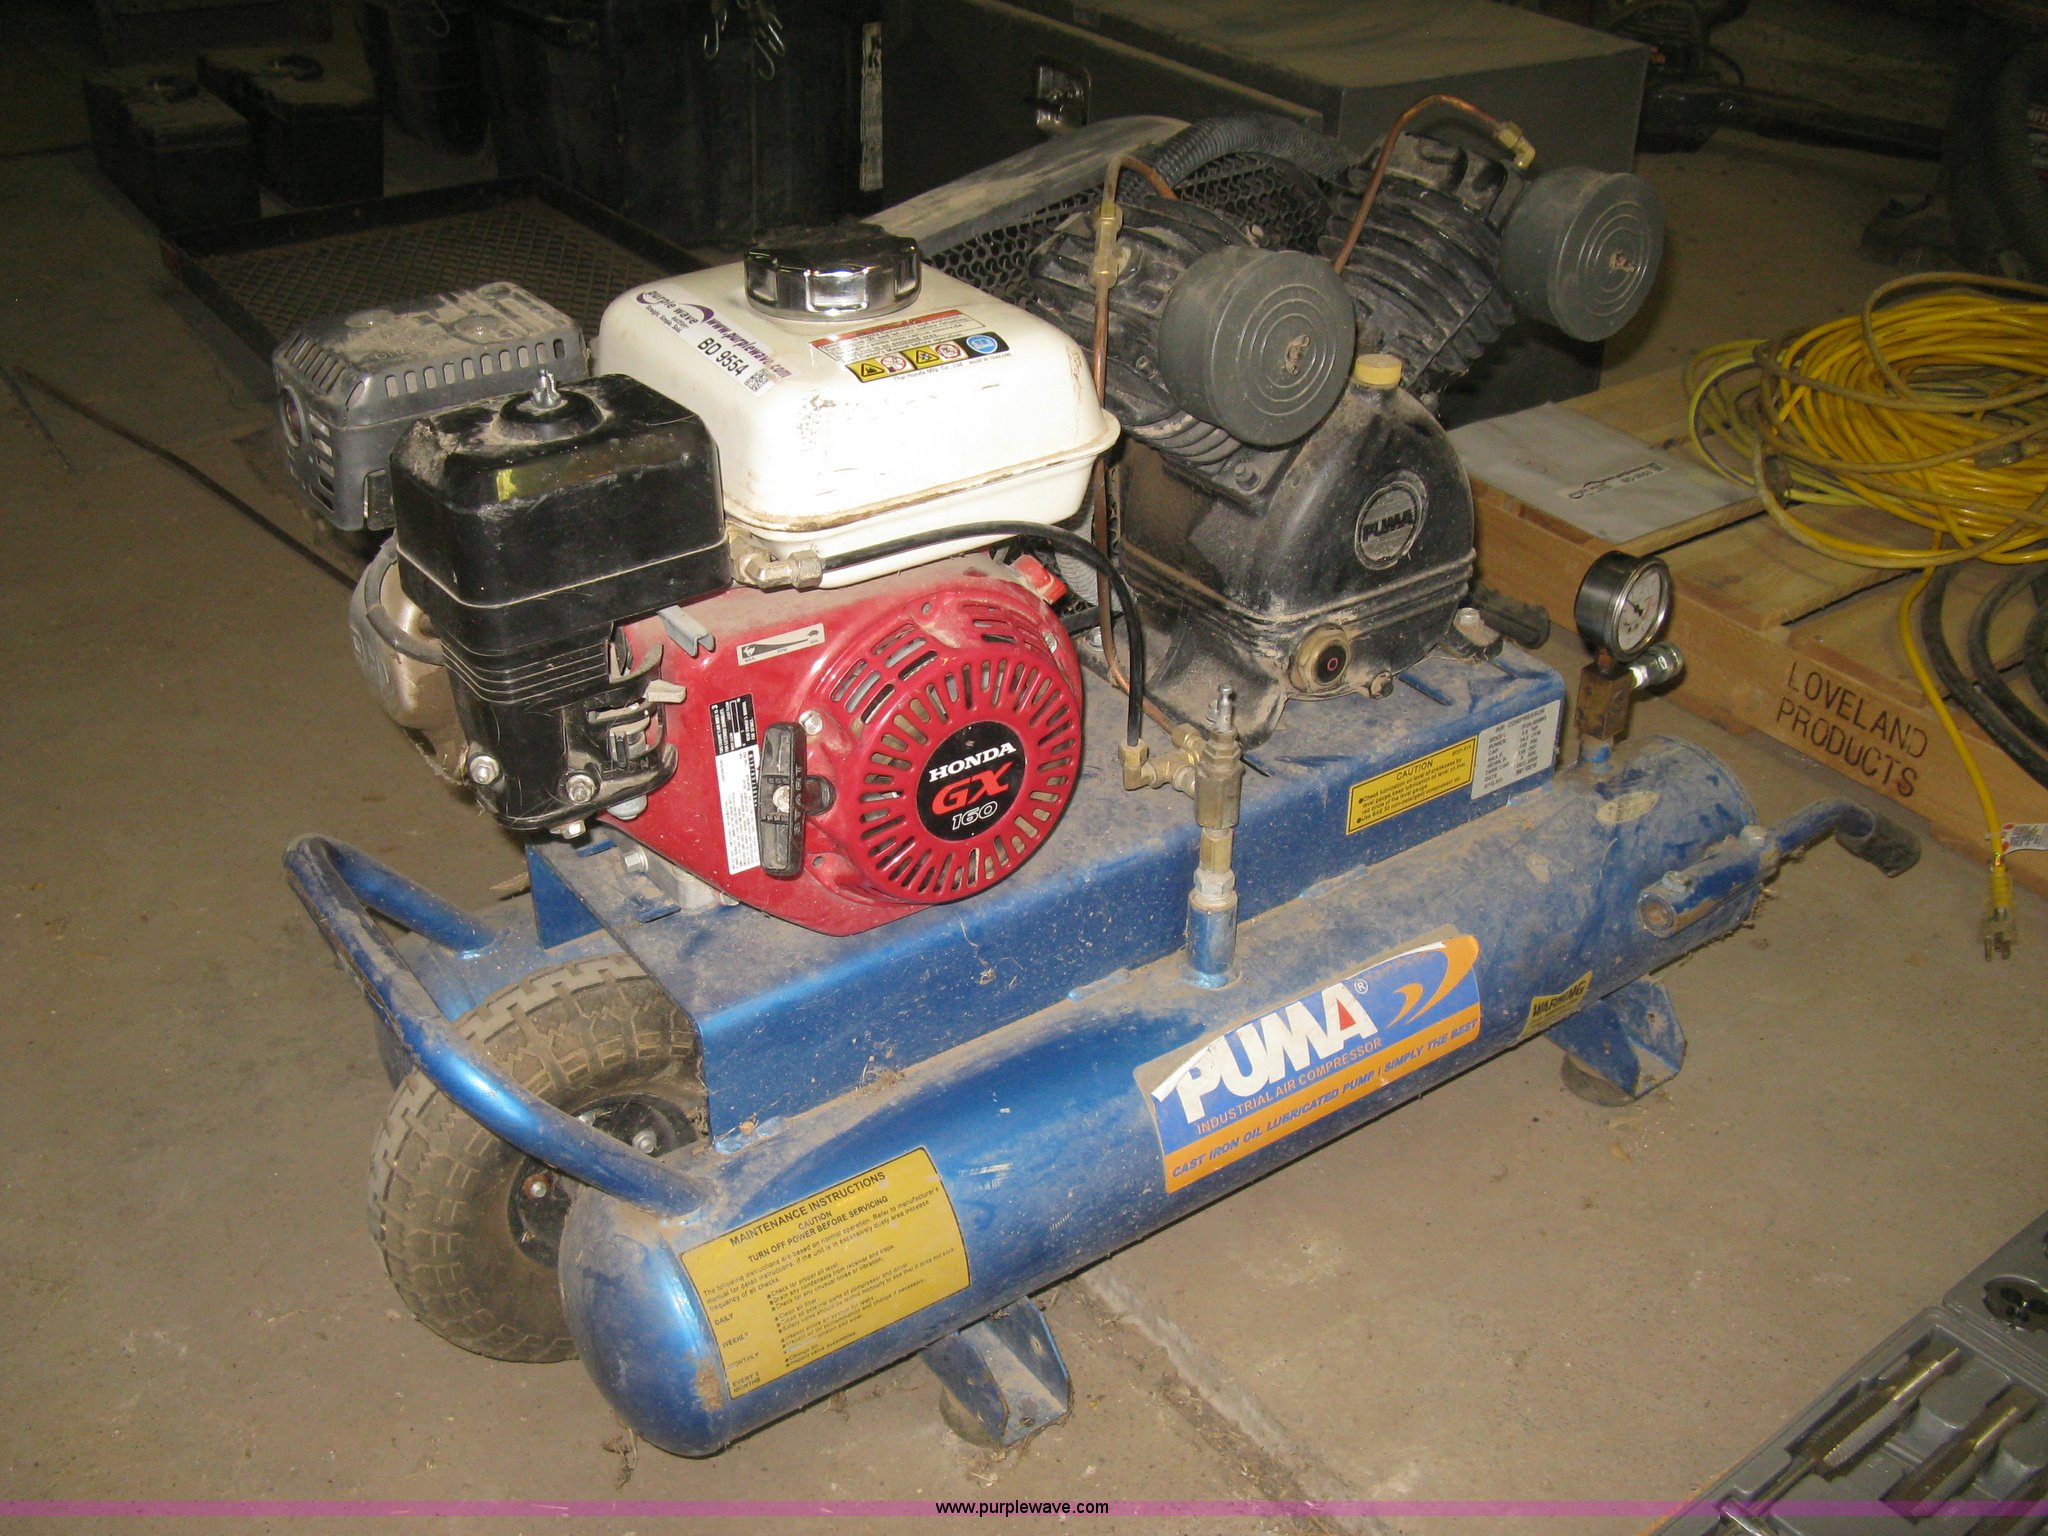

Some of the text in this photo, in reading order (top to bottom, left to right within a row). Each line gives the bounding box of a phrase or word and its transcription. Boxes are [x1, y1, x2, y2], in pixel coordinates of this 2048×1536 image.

[644, 289, 676, 309] purple
[674, 306, 698, 325] wave
[697, 337, 749, 377] BD 9554
[1363, 507, 1415, 542] PUMA
[1787, 661, 1928, 758] LOVELAND
[929, 742, 1016, 782] HONDA
[1776, 696, 1918, 797] PRODUCTS
[931, 761, 1015, 815] GX
[1396, 759, 1433, 780] CAUTION
[952, 800, 998, 831] 160
[1176, 982, 1378, 1125] PUMA
[1171, 1018, 1477, 1178] CAST IRON OIL LUBRICATED PUMP SIMPLY THE BEST
[1195, 1036, 1382, 1135] INDUSTRIAL AIR COMPRESSOR
[729, 1170, 886, 1246] MAINTENANCE INSTRUCTIONS
[797, 1209, 832, 1230] CAUTION
[703, 1286, 716, 1297] The
[716, 1273, 744, 1291] following
[744, 1257, 780, 1278] instructions
[791, 1243, 811, 1257] based
[811, 1239, 820, 1248] on
[820, 1230, 841, 1244] normal
[872, 1208, 889, 1221] Refer
[889, 1205, 897, 1213] to
[896, 1186, 938, 1210] manufacturer's
[747, 1195, 888, 1263] TURN OFF POWER BEFORE SERVICING
[706, 1289, 729, 1304] manual
[729, 1285, 739, 1294] for
[739, 1277, 757, 1289] detail
[801, 1252, 812, 1261] the
[812, 1246, 824, 1256] unit
[831, 1240, 838, 1248] in
[873, 1217, 890, 1229] dusty
[890, 1211, 904, 1221] area
[904, 1199, 929, 1215] increase
[771, 1285, 788, 1296] Check
[773, 1292, 789, 1303] Drain
[832, 1266, 845, 1276] from
[868, 1251, 879, 1259] and
[709, 1294, 740, 1313] frequency
[741, 1290, 748, 1298] of
[748, 1287, 757, 1295] all
[714, 1312, 734, 1326] DAILY
[775, 1298, 792, 1309] Check
[721, 1331, 749, 1348] WEEKLY
[732, 1373, 753, 1387] EVERY
[733, 1376, 761, 1393] MONTHS
